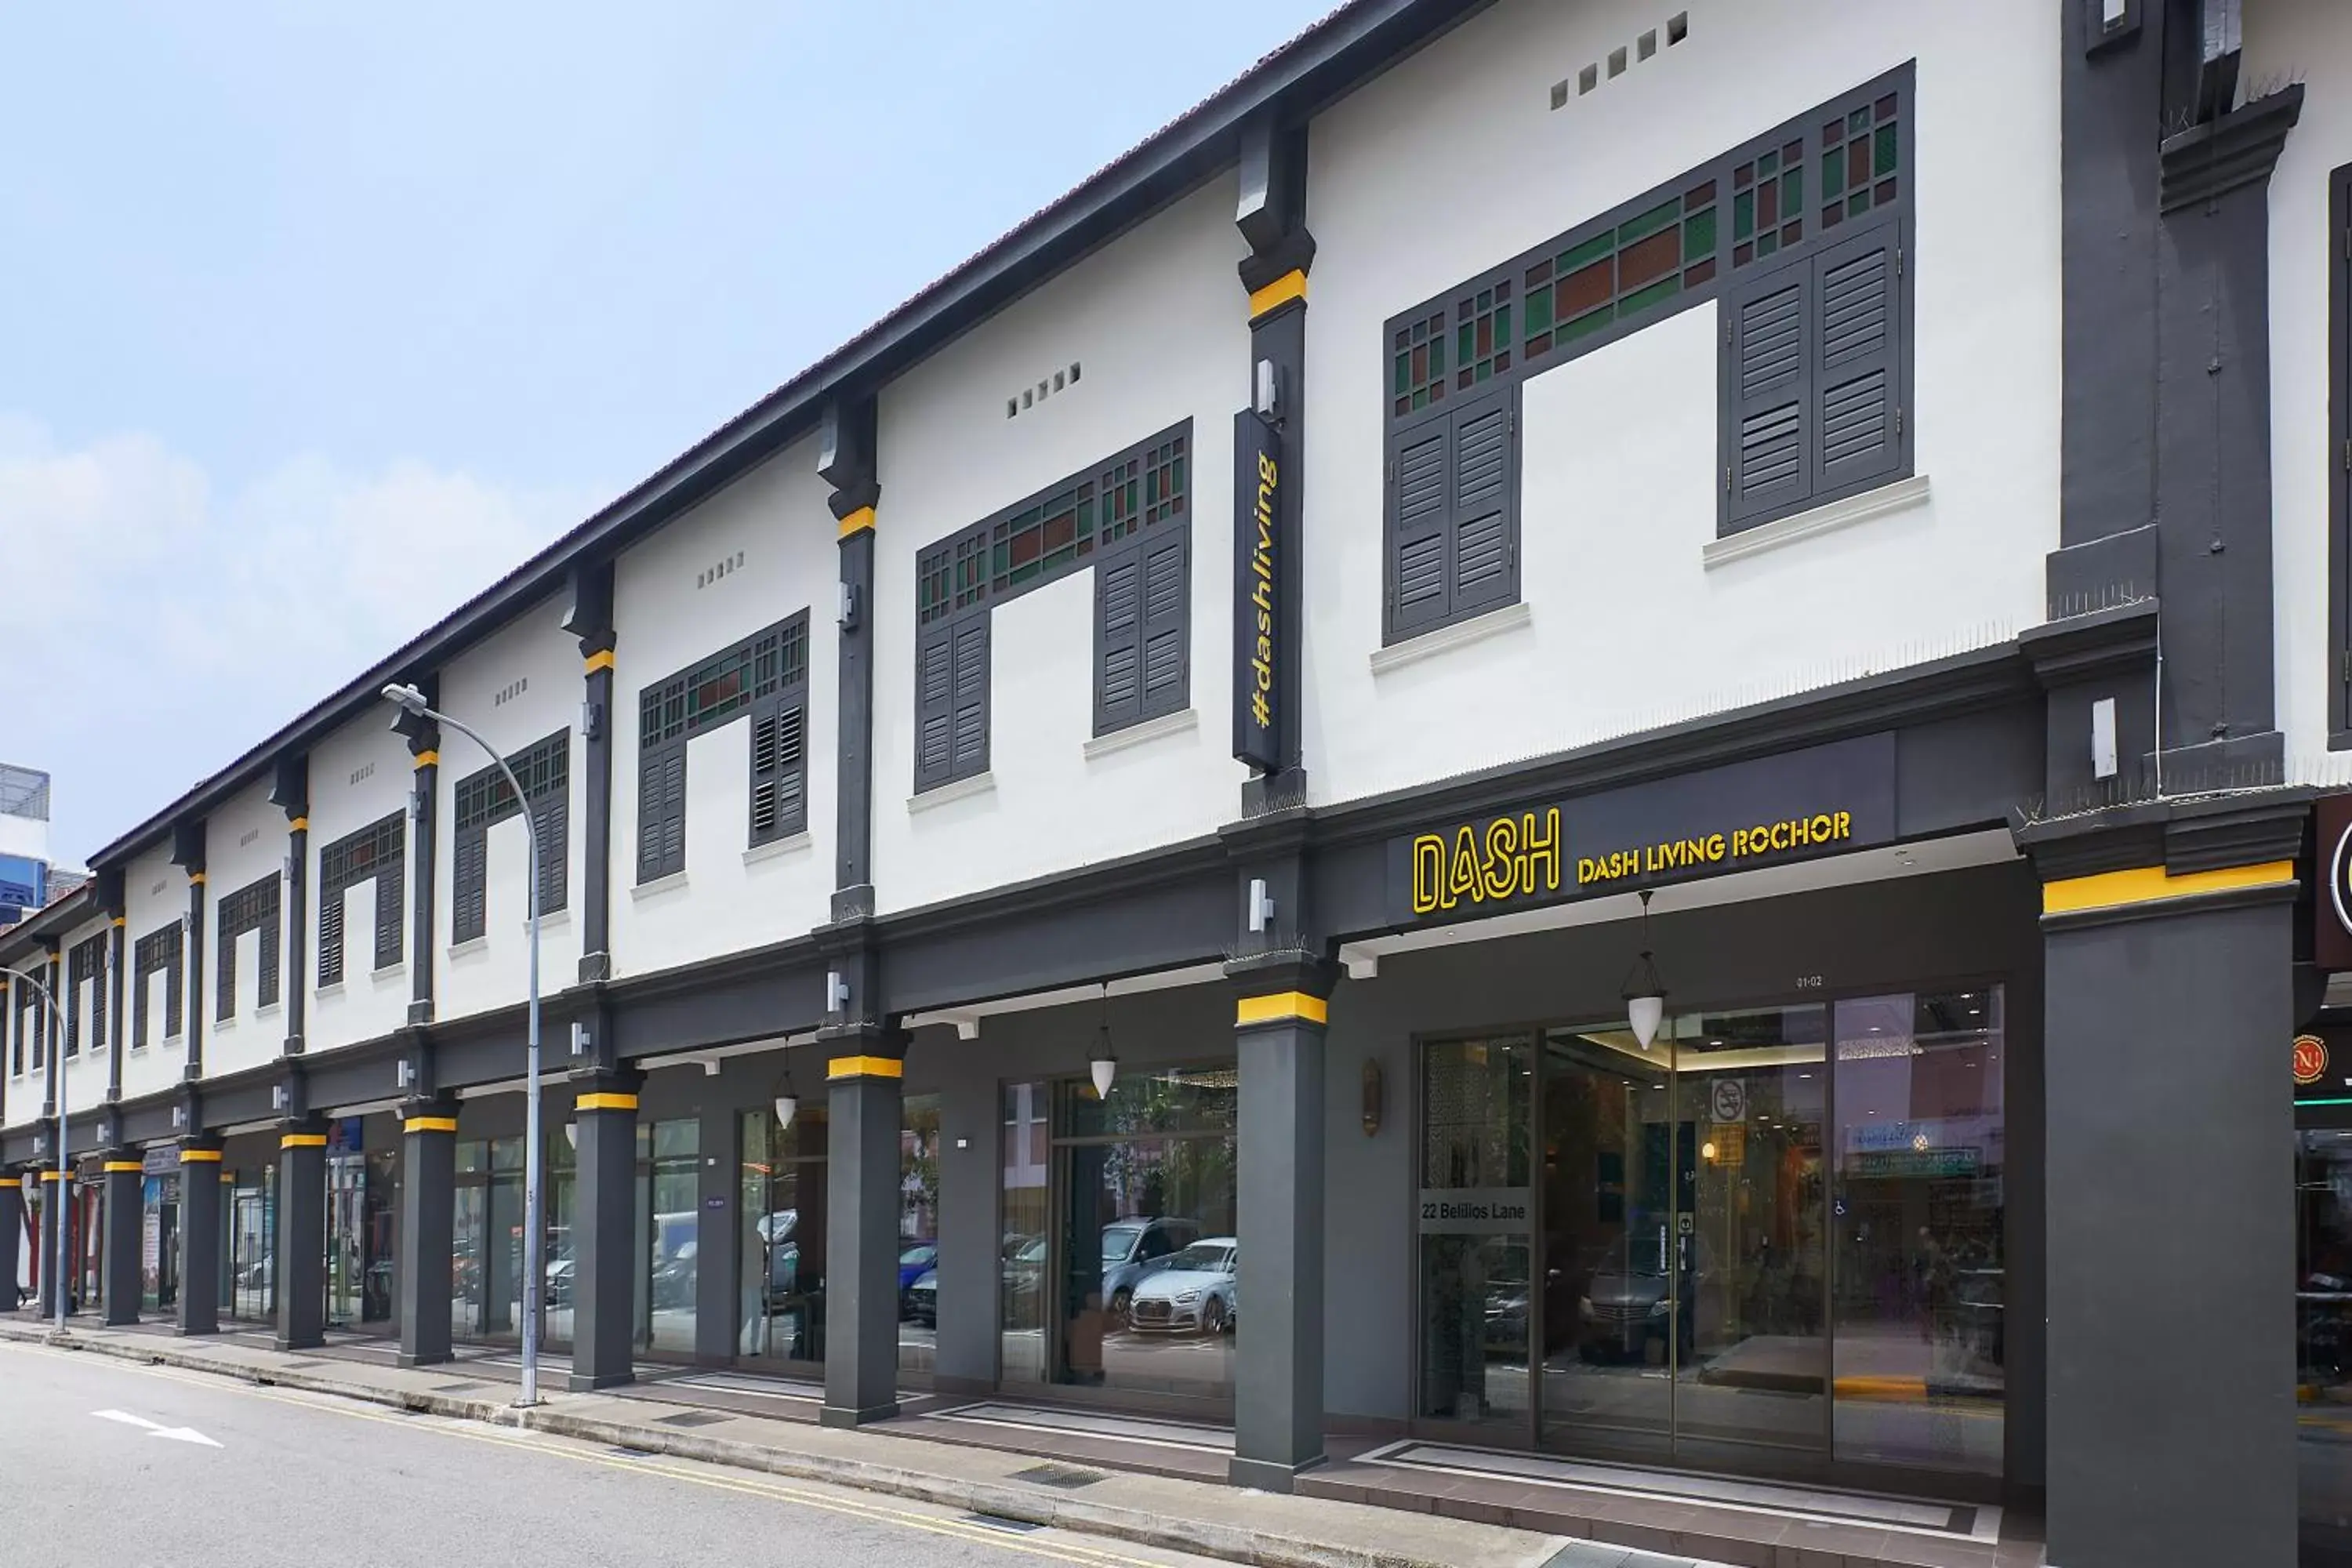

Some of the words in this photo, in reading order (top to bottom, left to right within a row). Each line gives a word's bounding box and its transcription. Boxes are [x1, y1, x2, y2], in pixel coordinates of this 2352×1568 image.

[1252, 449, 1278, 729] #dashliving
[1414, 808, 1559, 913] DASH
[1578, 849, 1639, 884] DASH
[1647, 833, 1726, 872] LIVING
[1733, 811, 1851, 856] ROCHOR
[1421, 1203, 1436, 1219] 22
[1492, 1203, 1526, 1219] Lane
